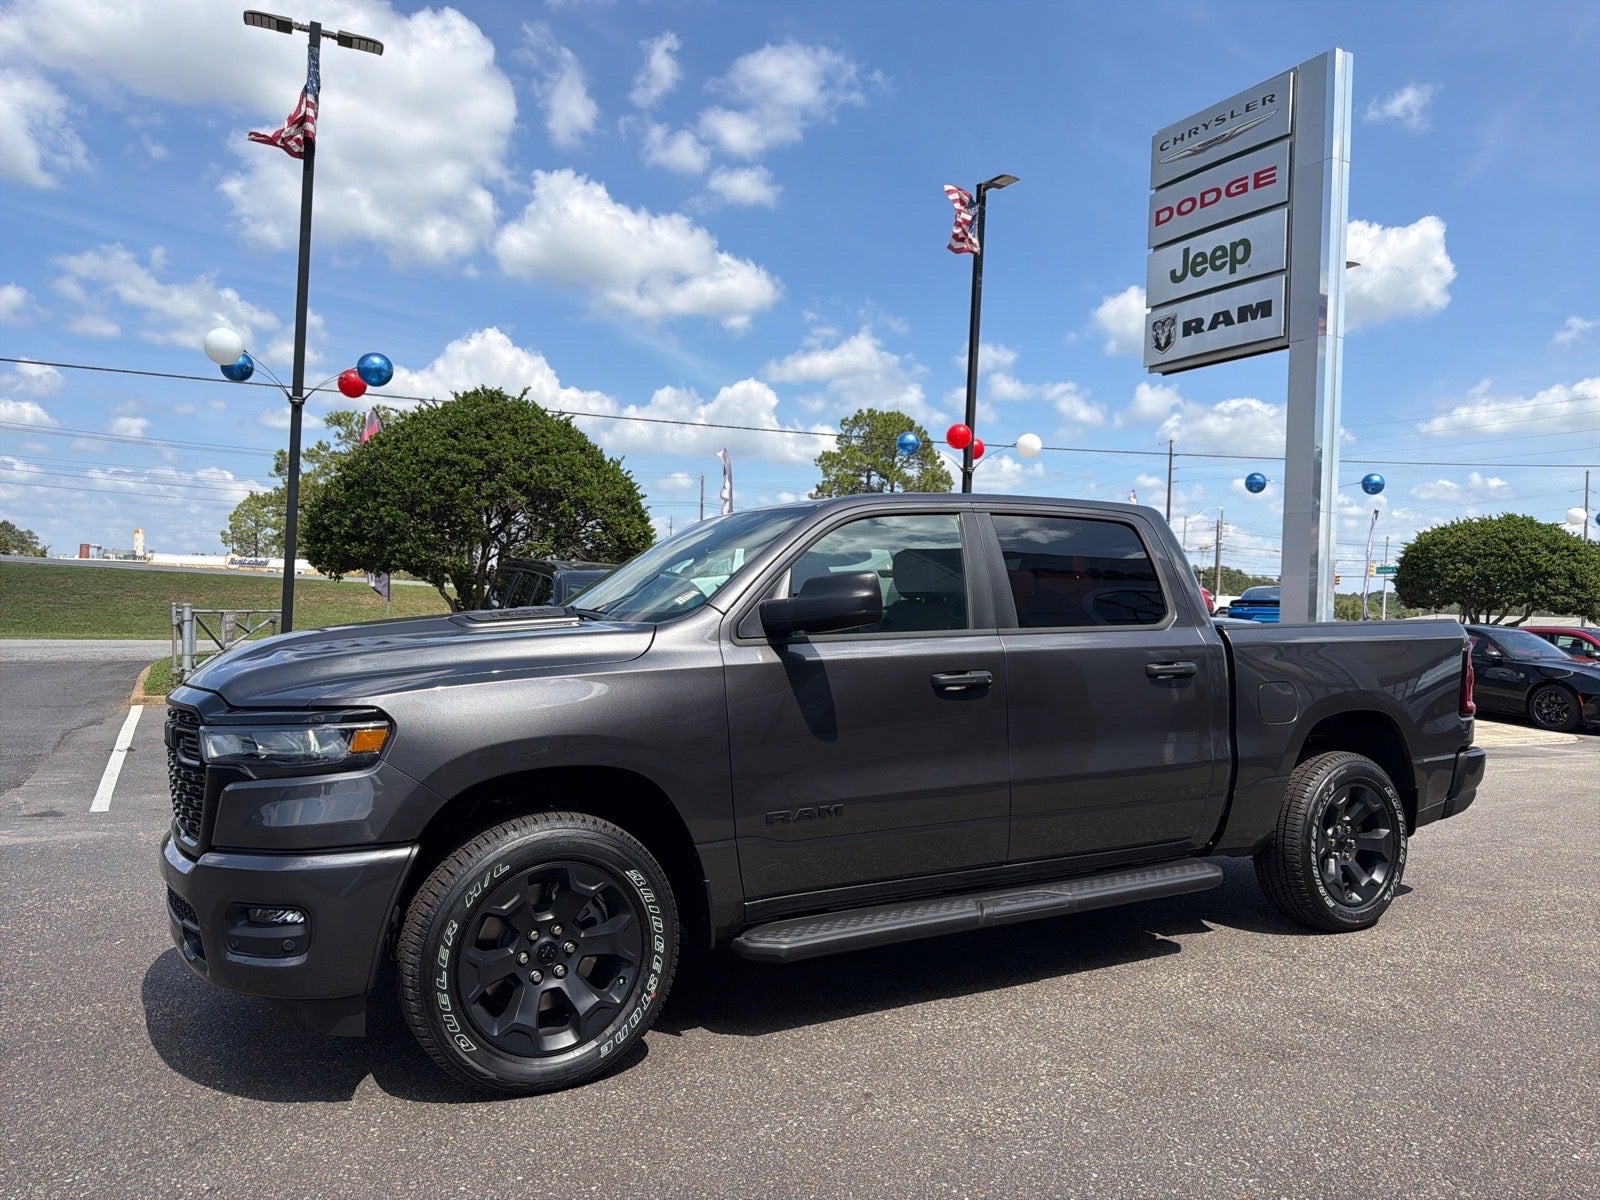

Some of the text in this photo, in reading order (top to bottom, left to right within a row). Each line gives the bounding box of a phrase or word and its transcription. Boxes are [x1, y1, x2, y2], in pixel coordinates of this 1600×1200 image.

[1159, 93, 1276, 152] CHRYSLER
[1155, 166, 1278, 227] DODGE
[1170, 237, 1252, 284] Jeep
[1182, 299, 1273, 338] RAM
[766, 804, 844, 824] RAM
[436, 863, 510, 1053] DUELER H/L
[600, 869, 665, 1058] BRIDGESTONE
